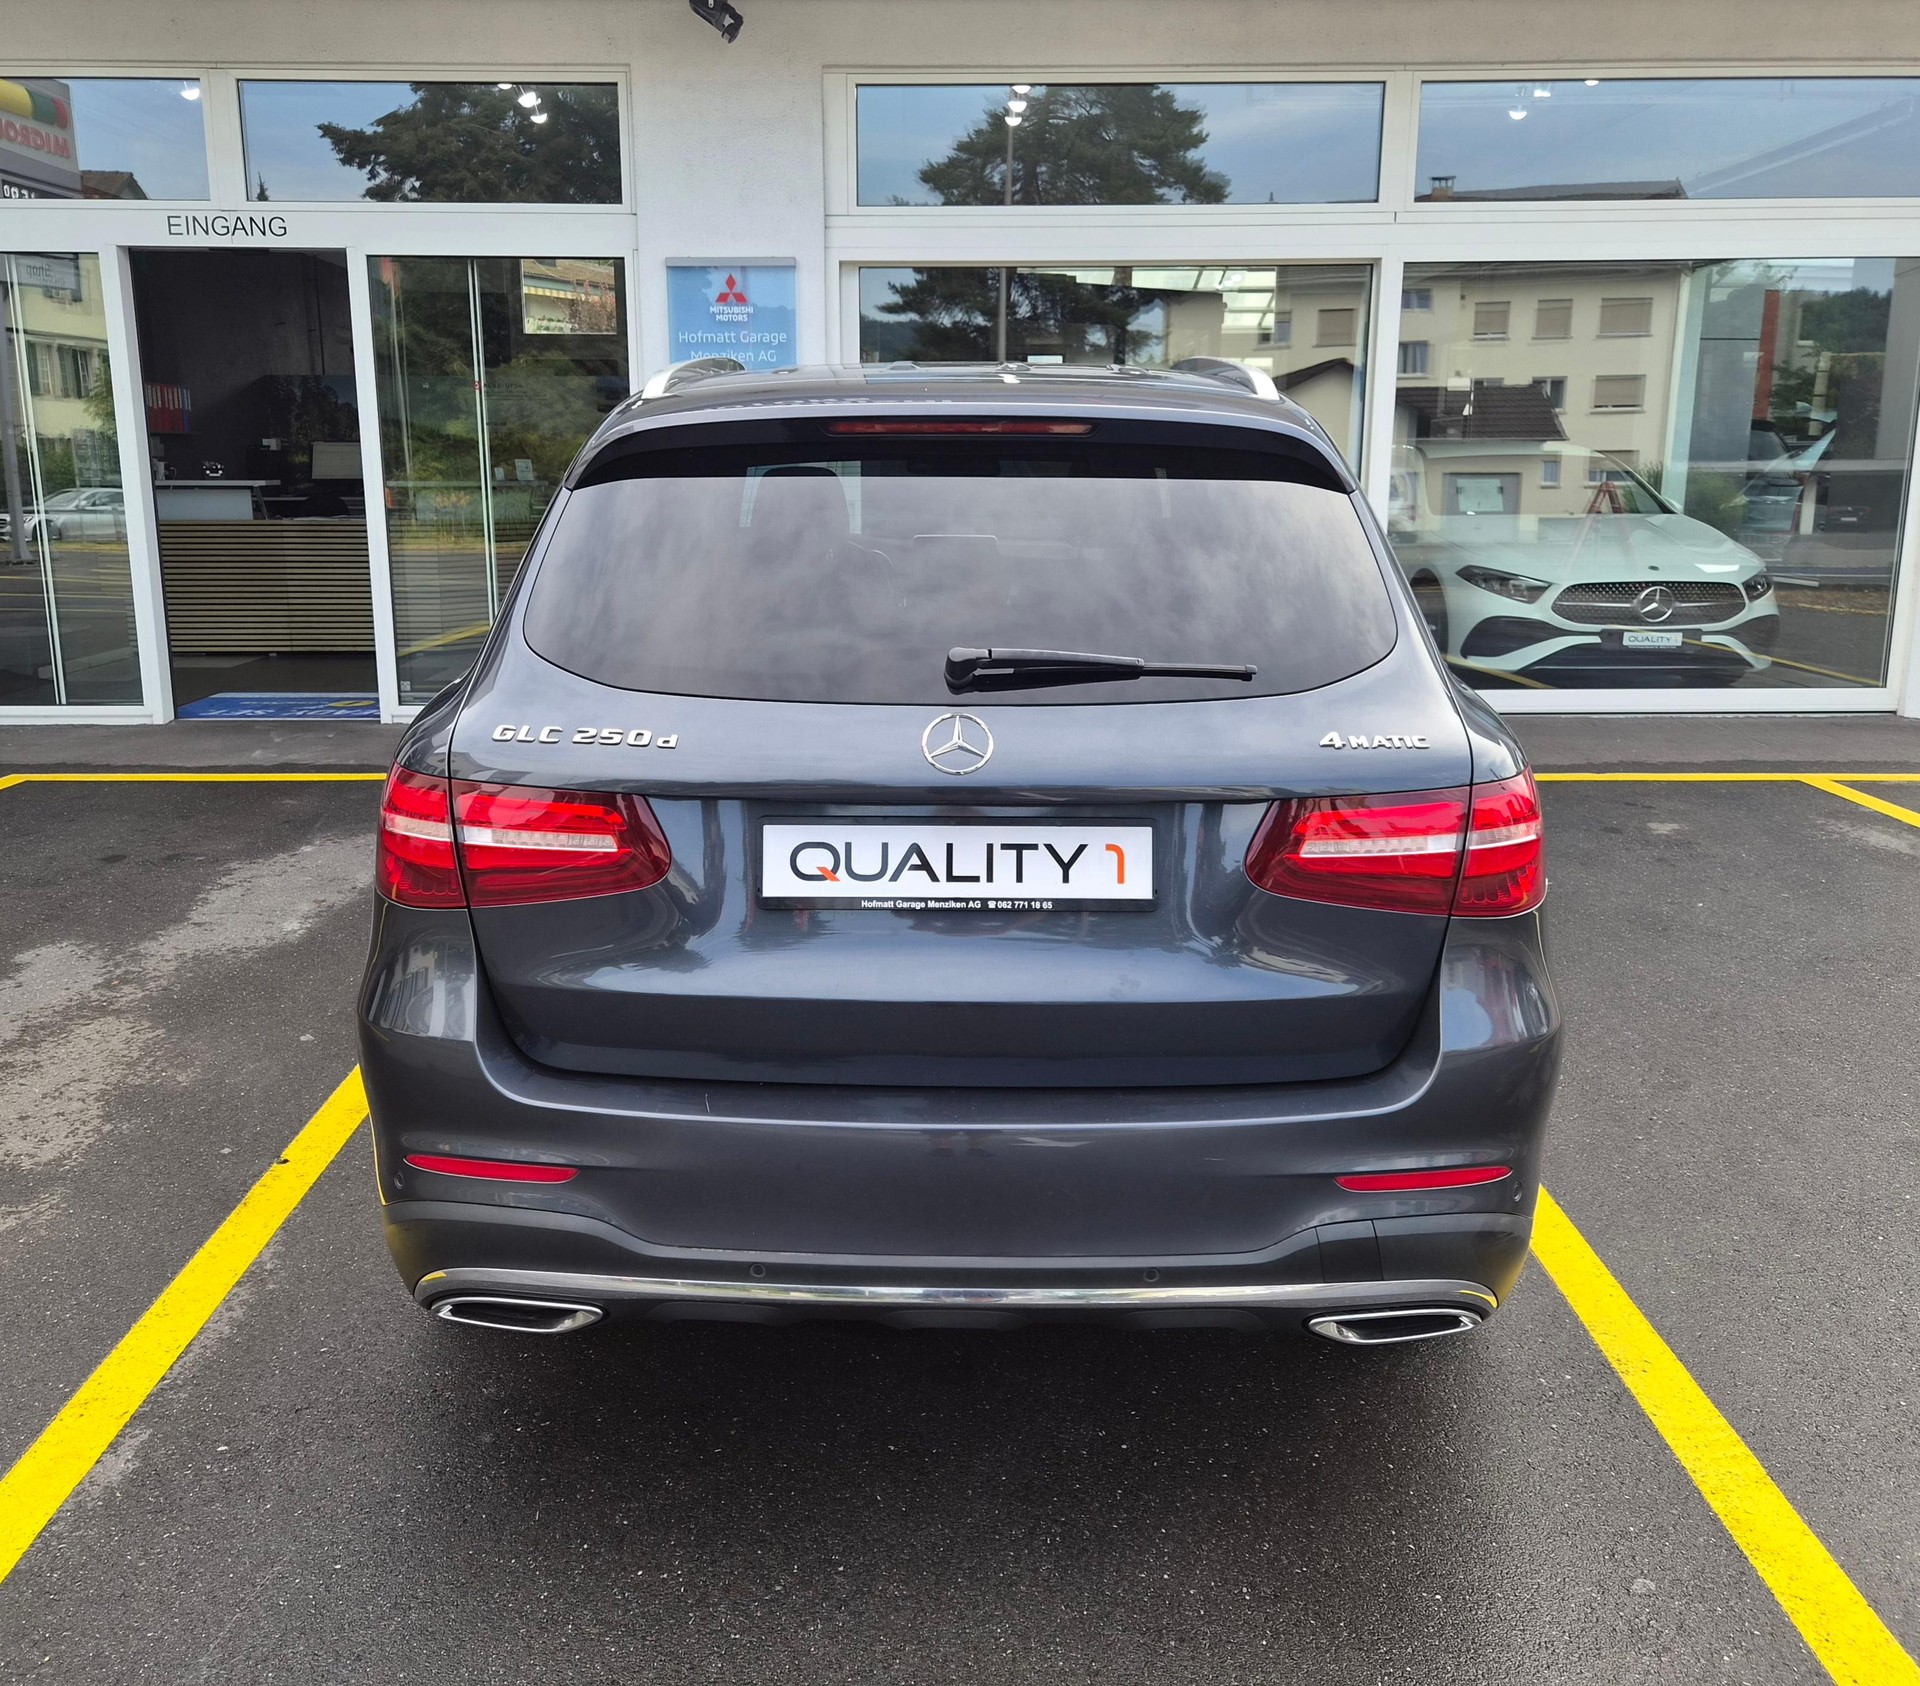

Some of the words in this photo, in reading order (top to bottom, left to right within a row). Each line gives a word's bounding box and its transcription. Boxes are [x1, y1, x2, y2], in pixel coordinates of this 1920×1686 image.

[166, 215, 288, 237] EINGANG
[709, 306, 754, 314] MITSUBISHI
[715, 314, 748, 322] MOTORS
[678, 331, 737, 343] Hofmatt
[740, 331, 787, 346] Garage
[758, 350, 777, 362] AG
[1628, 635, 1672, 643] QUALITY
[492, 724, 563, 744] GLC
[789, 841, 1089, 884] QUALITY
[1105, 843, 1125, 884] 1
[861, 900, 894, 908] Hofmatt
[896, 900, 926, 910] Garage
[927, 900, 966, 909] Menziken
[968, 900, 981, 909] AG
[997, 901, 1012, 909] 062
[1014, 901, 1028, 909] 771
[1030, 901, 1041, 909] 18
[1042, 901, 1053, 909] 65
